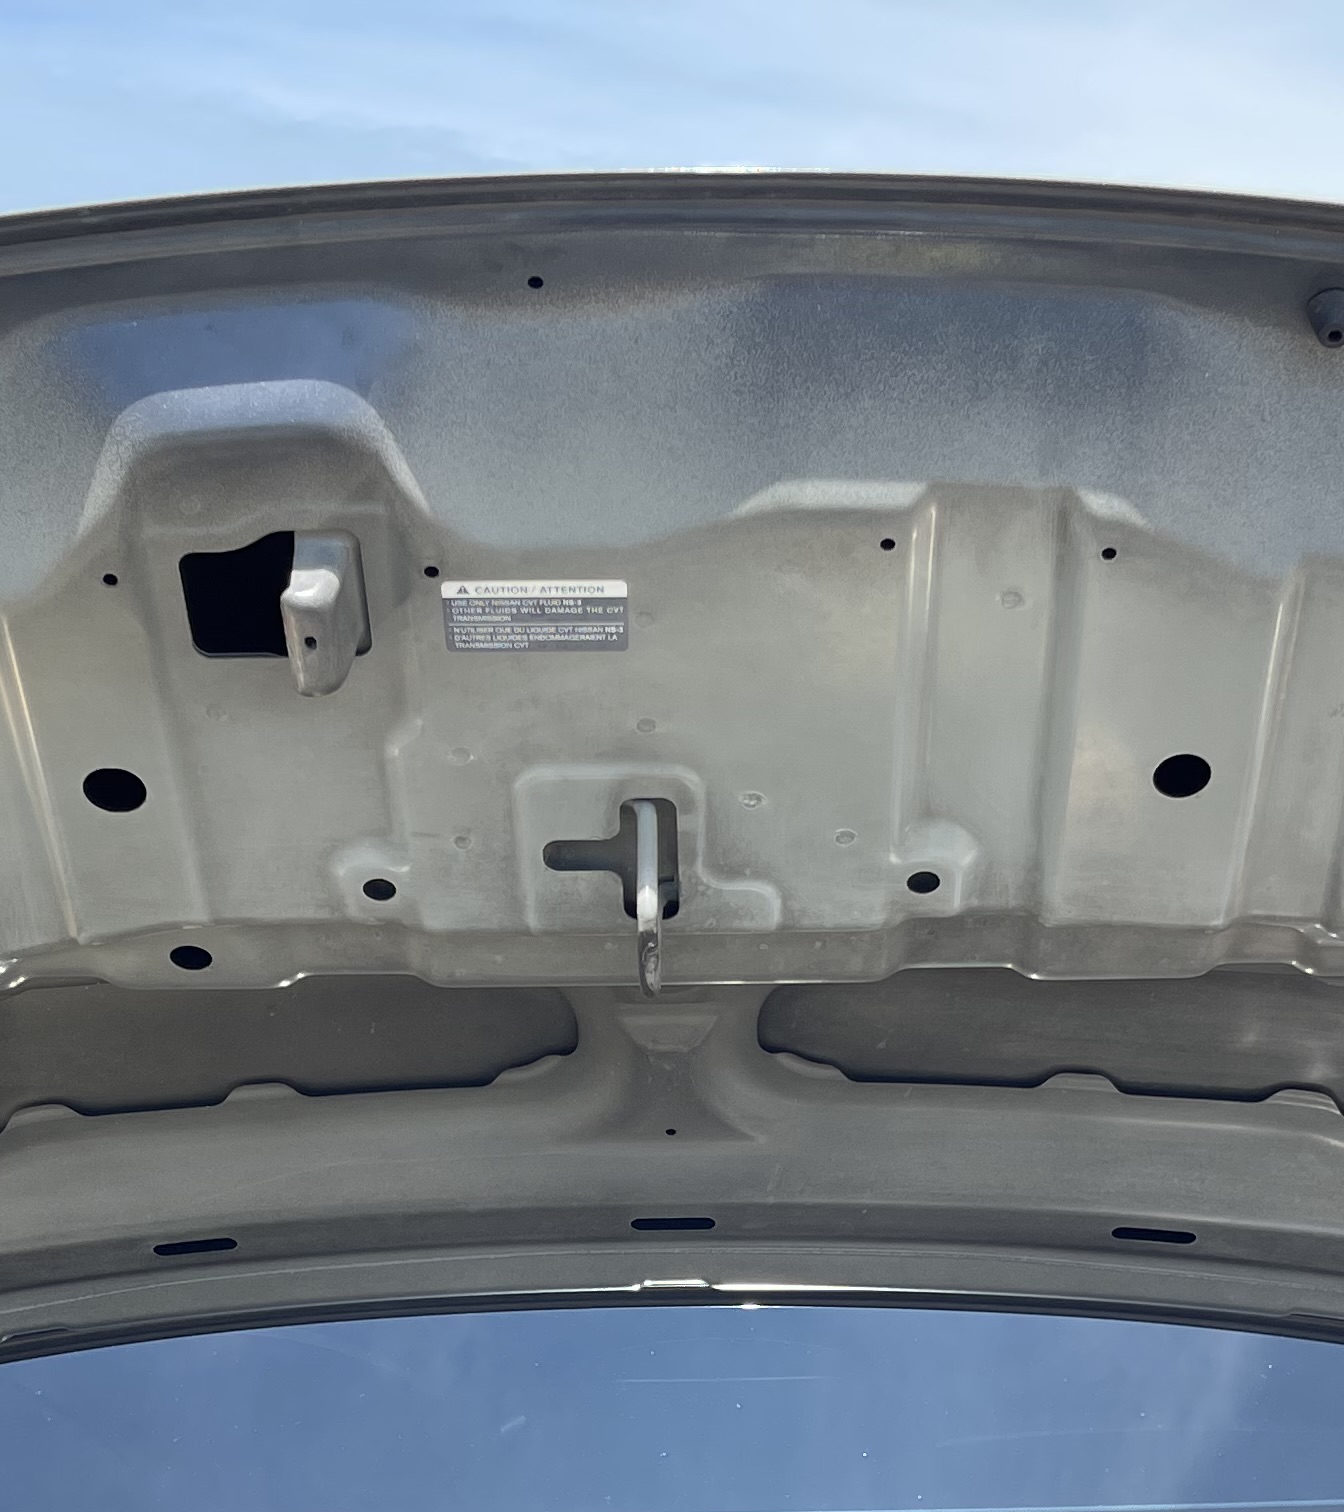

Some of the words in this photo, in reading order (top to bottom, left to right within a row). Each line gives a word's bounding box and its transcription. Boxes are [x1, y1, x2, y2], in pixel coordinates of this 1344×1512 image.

[475, 586, 528, 594] CAUTION
[540, 585, 605, 594] ATTENTION
[586, 606, 603, 614] THE
[606, 606, 624, 614] CVT
